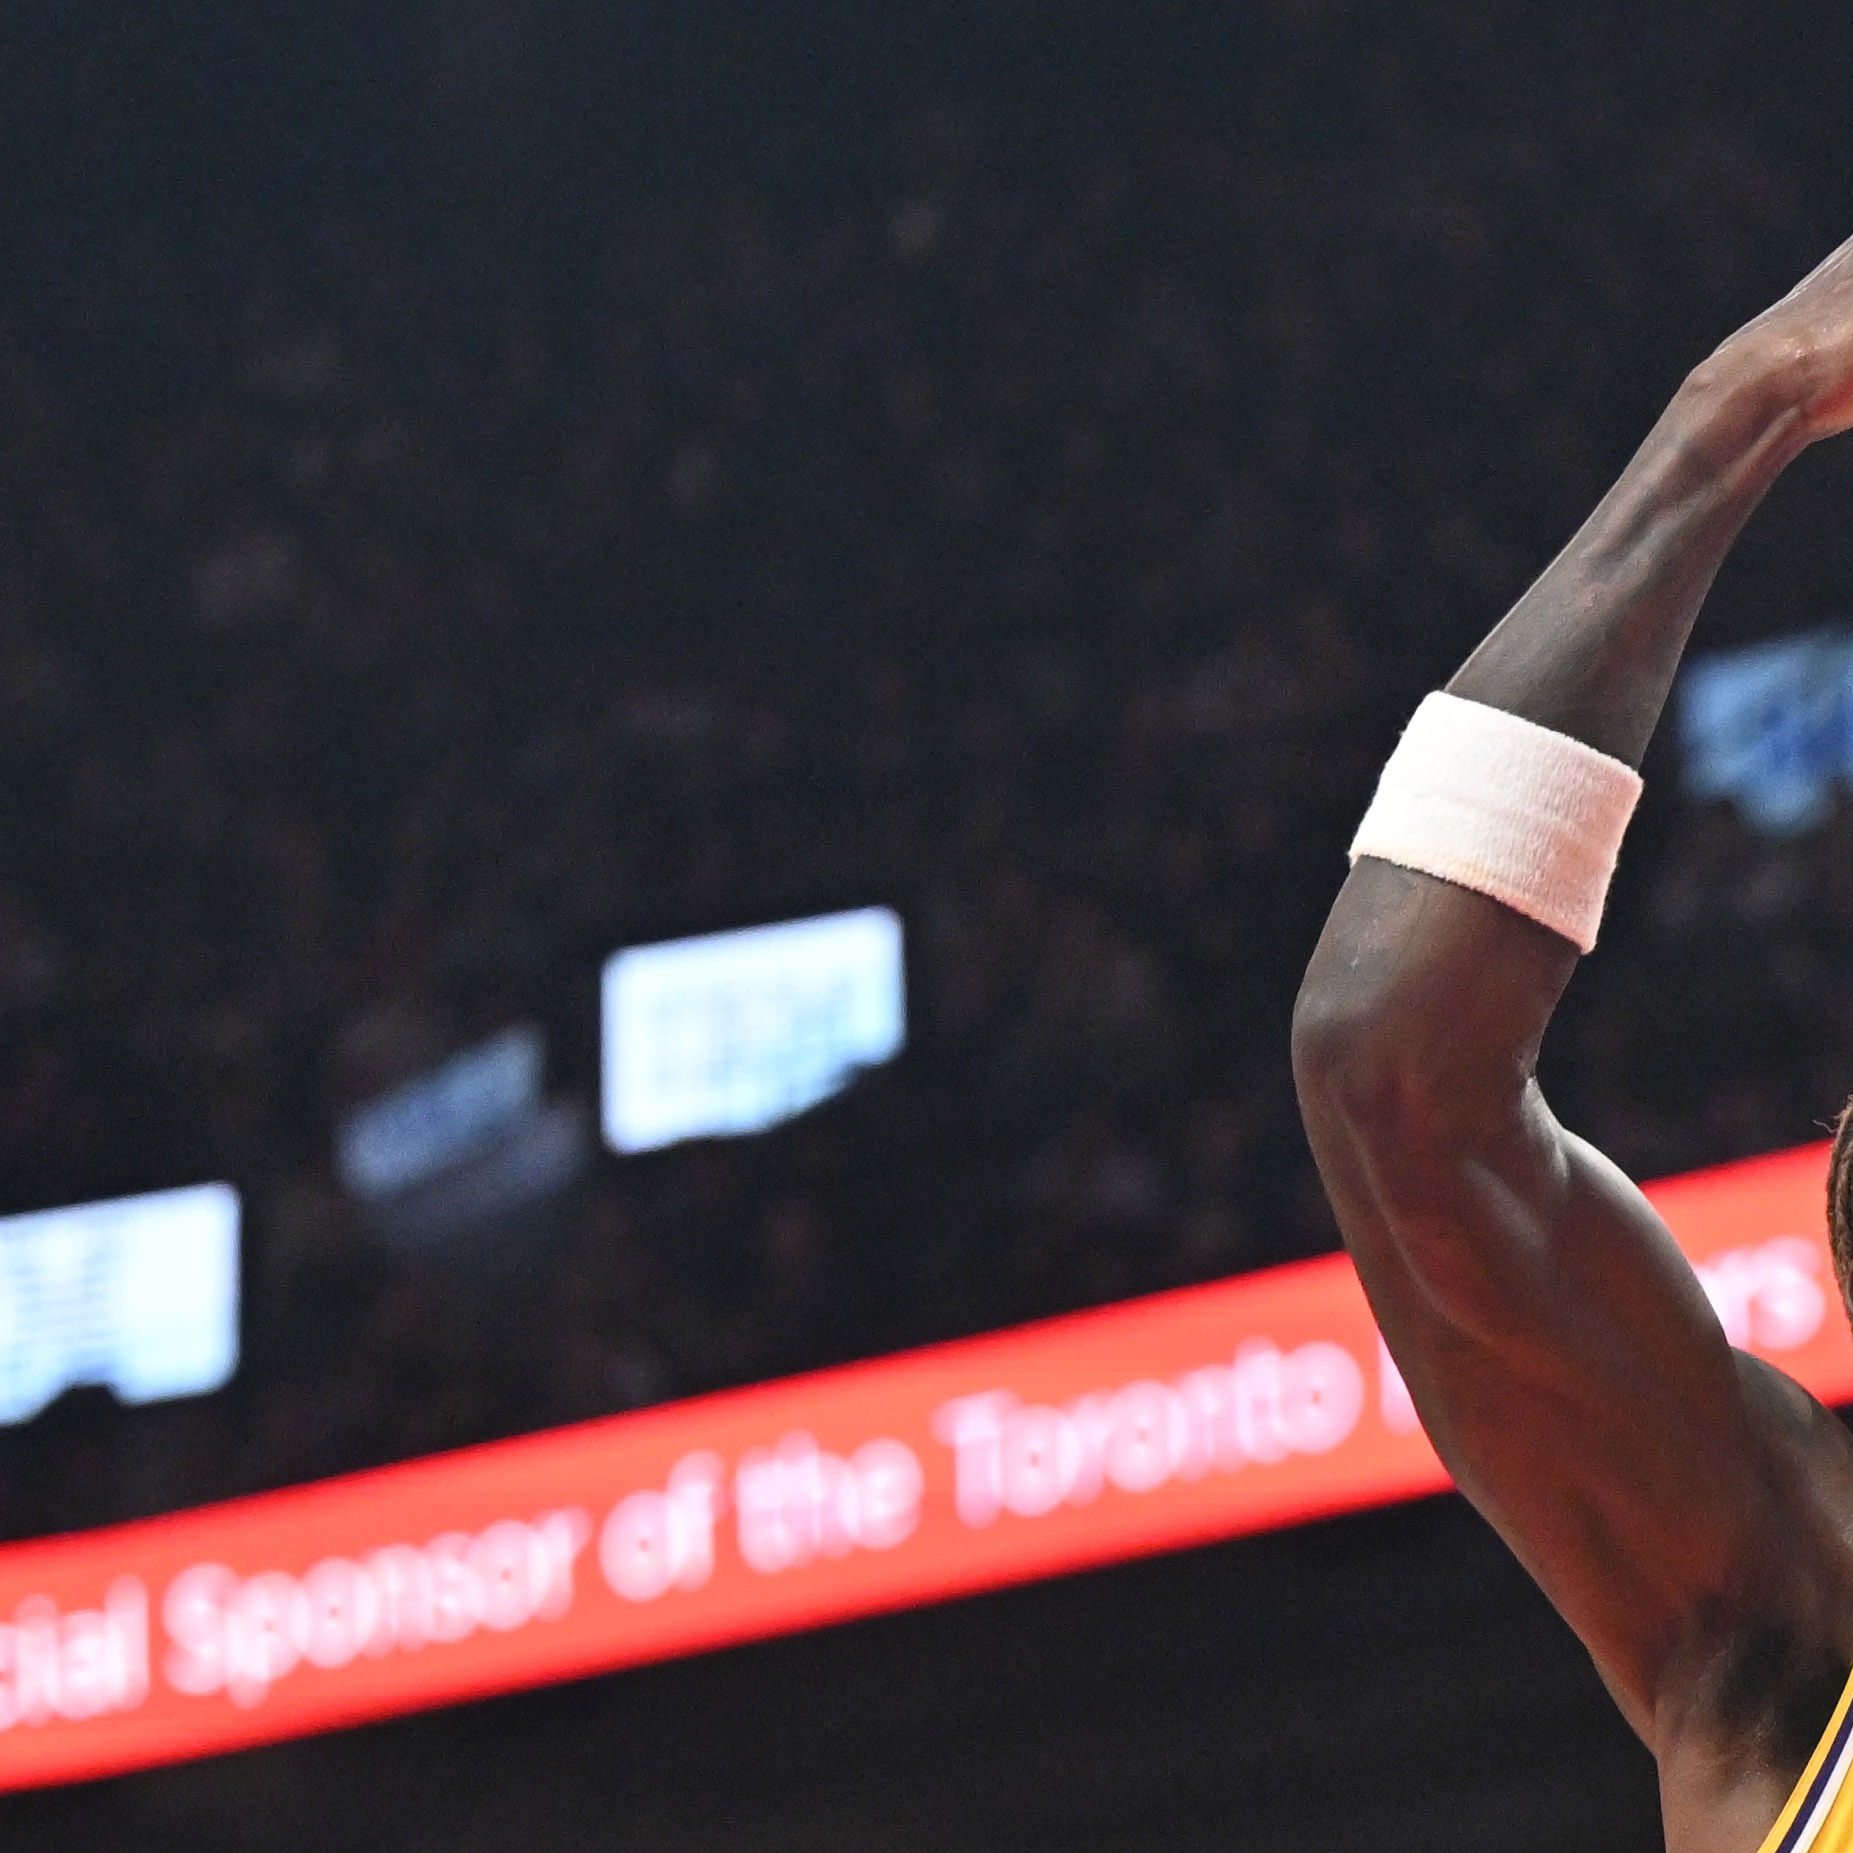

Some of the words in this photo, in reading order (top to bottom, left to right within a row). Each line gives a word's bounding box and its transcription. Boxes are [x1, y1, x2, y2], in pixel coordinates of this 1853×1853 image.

[163, 1506, 592, 1709] Sponsor
[600, 1450, 725, 1602] of
[735, 1429, 924, 1574] the
[931, 1336, 1364, 1530] Toronto
